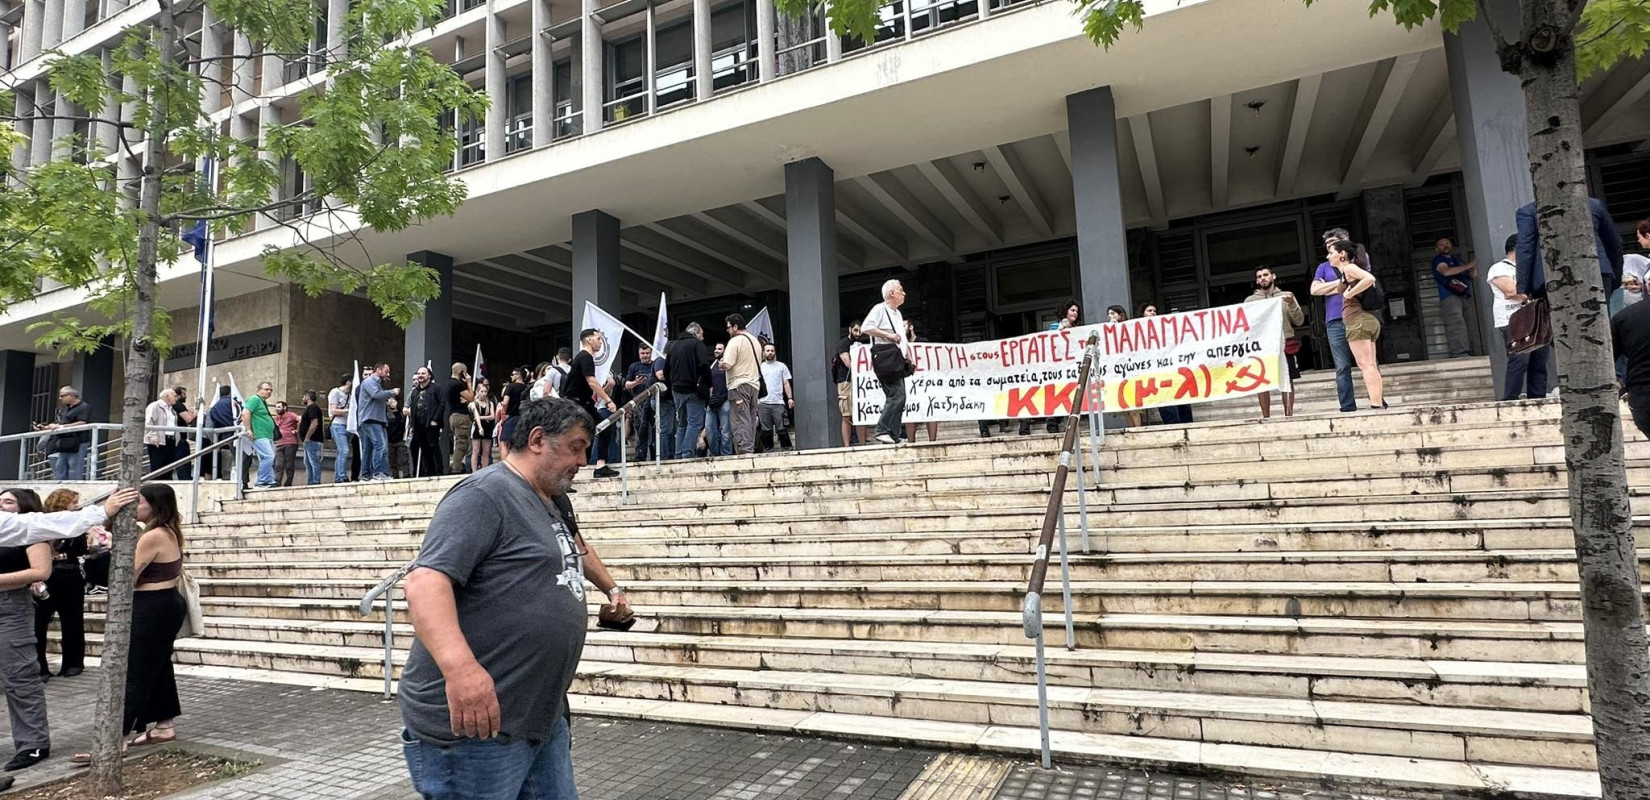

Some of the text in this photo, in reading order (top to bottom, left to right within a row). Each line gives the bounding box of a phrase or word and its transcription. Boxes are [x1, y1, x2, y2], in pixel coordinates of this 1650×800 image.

[229, 338, 276, 359] ΜΕΓΑΡΟ
[1000, 331, 1075, 367] ΕΡΓΑΤΕΣ
[1103, 306, 1250, 356] ΜΑΛΑΜΑΤΙΝΑ
[949, 375, 965, 387] από
[970, 378, 981, 386] τα
[1114, 358, 1152, 378] αγώνες
[1156, 356, 1173, 368] και
[1178, 351, 1196, 364] την
[1206, 336, 1262, 358] απεργία
[1117, 364, 1211, 410] (μ-λ)
